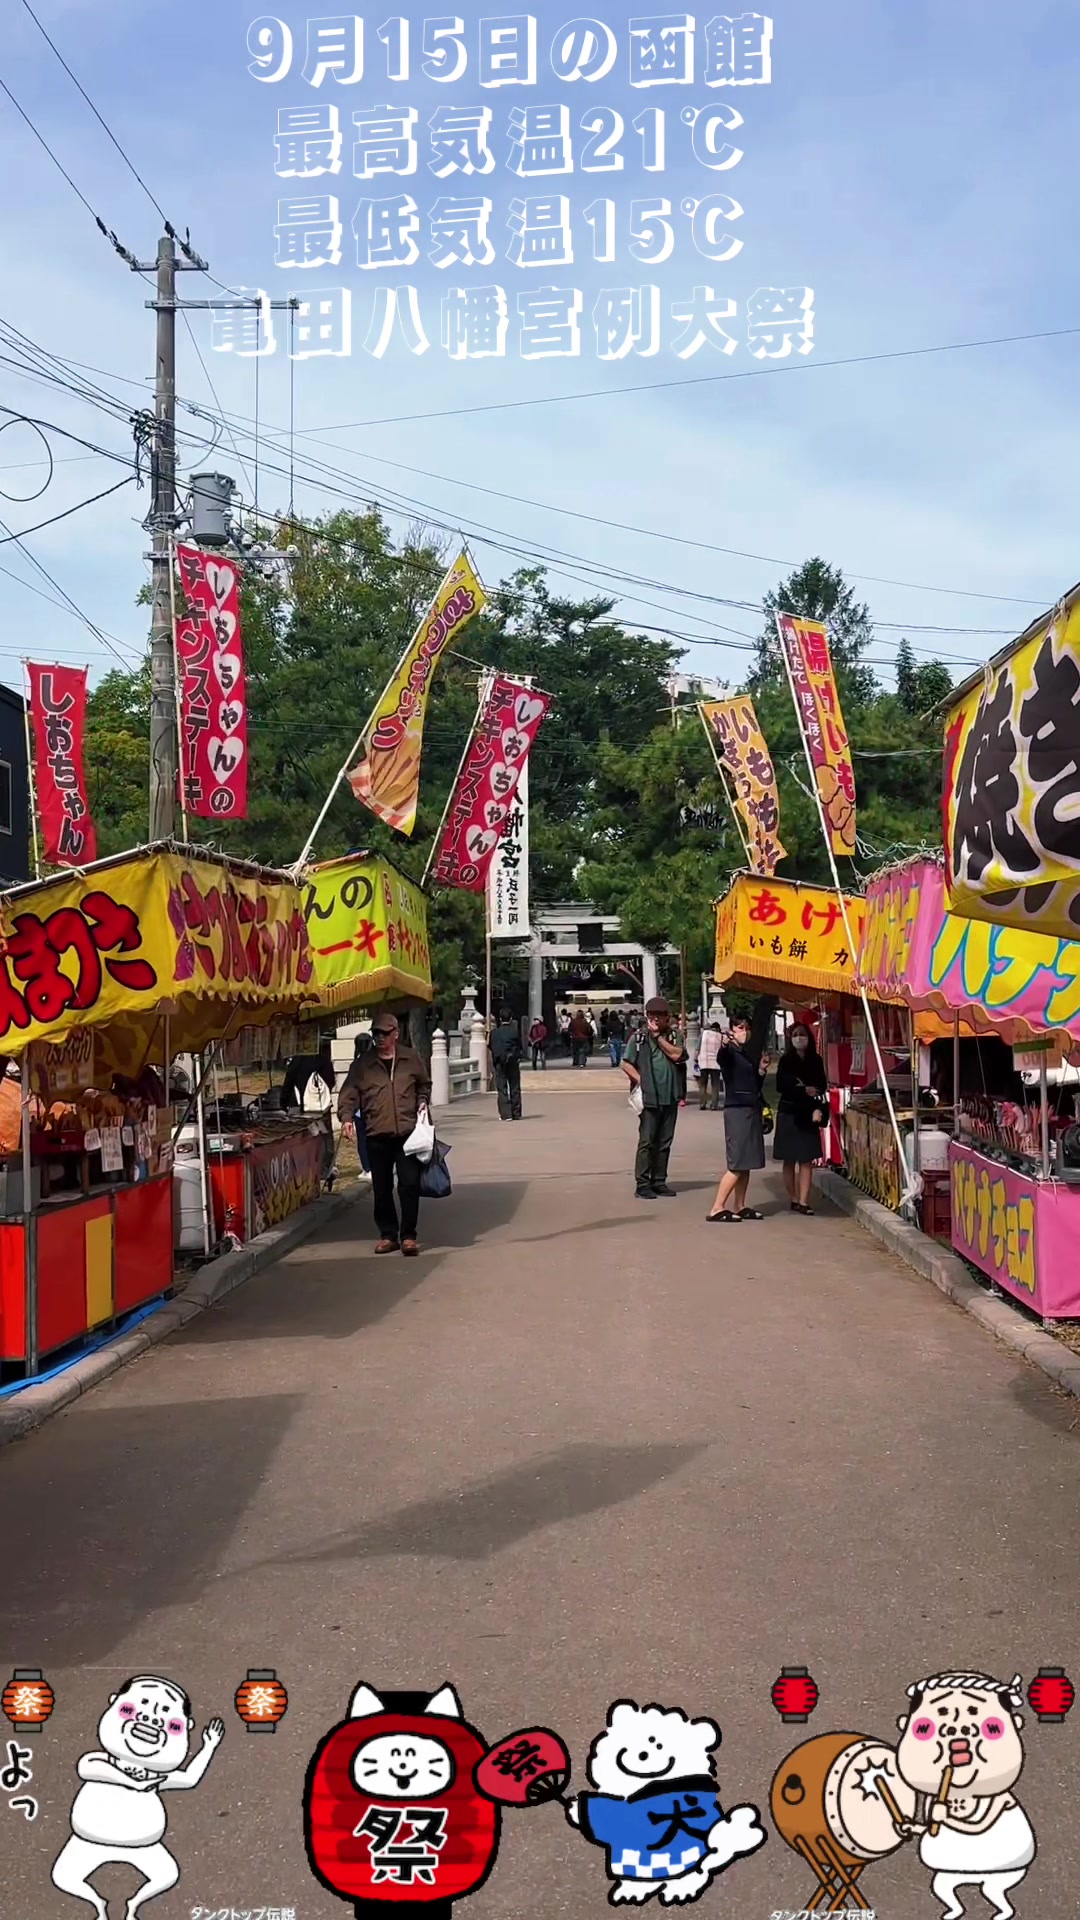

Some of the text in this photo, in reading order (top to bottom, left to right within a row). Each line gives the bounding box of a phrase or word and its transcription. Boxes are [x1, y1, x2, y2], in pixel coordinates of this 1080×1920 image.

[40, 672, 86, 857] しおちゃん
[179, 553, 211, 811] チキンステーキ
[209, 571, 238, 814] しおちゃんの
[437, 685, 515, 886] チキンステーキ
[458, 700, 532, 885] しおちゃんの
[749, 935, 808, 961] いも餅
[953, 1157, 1037, 1294] バナナチョコ
